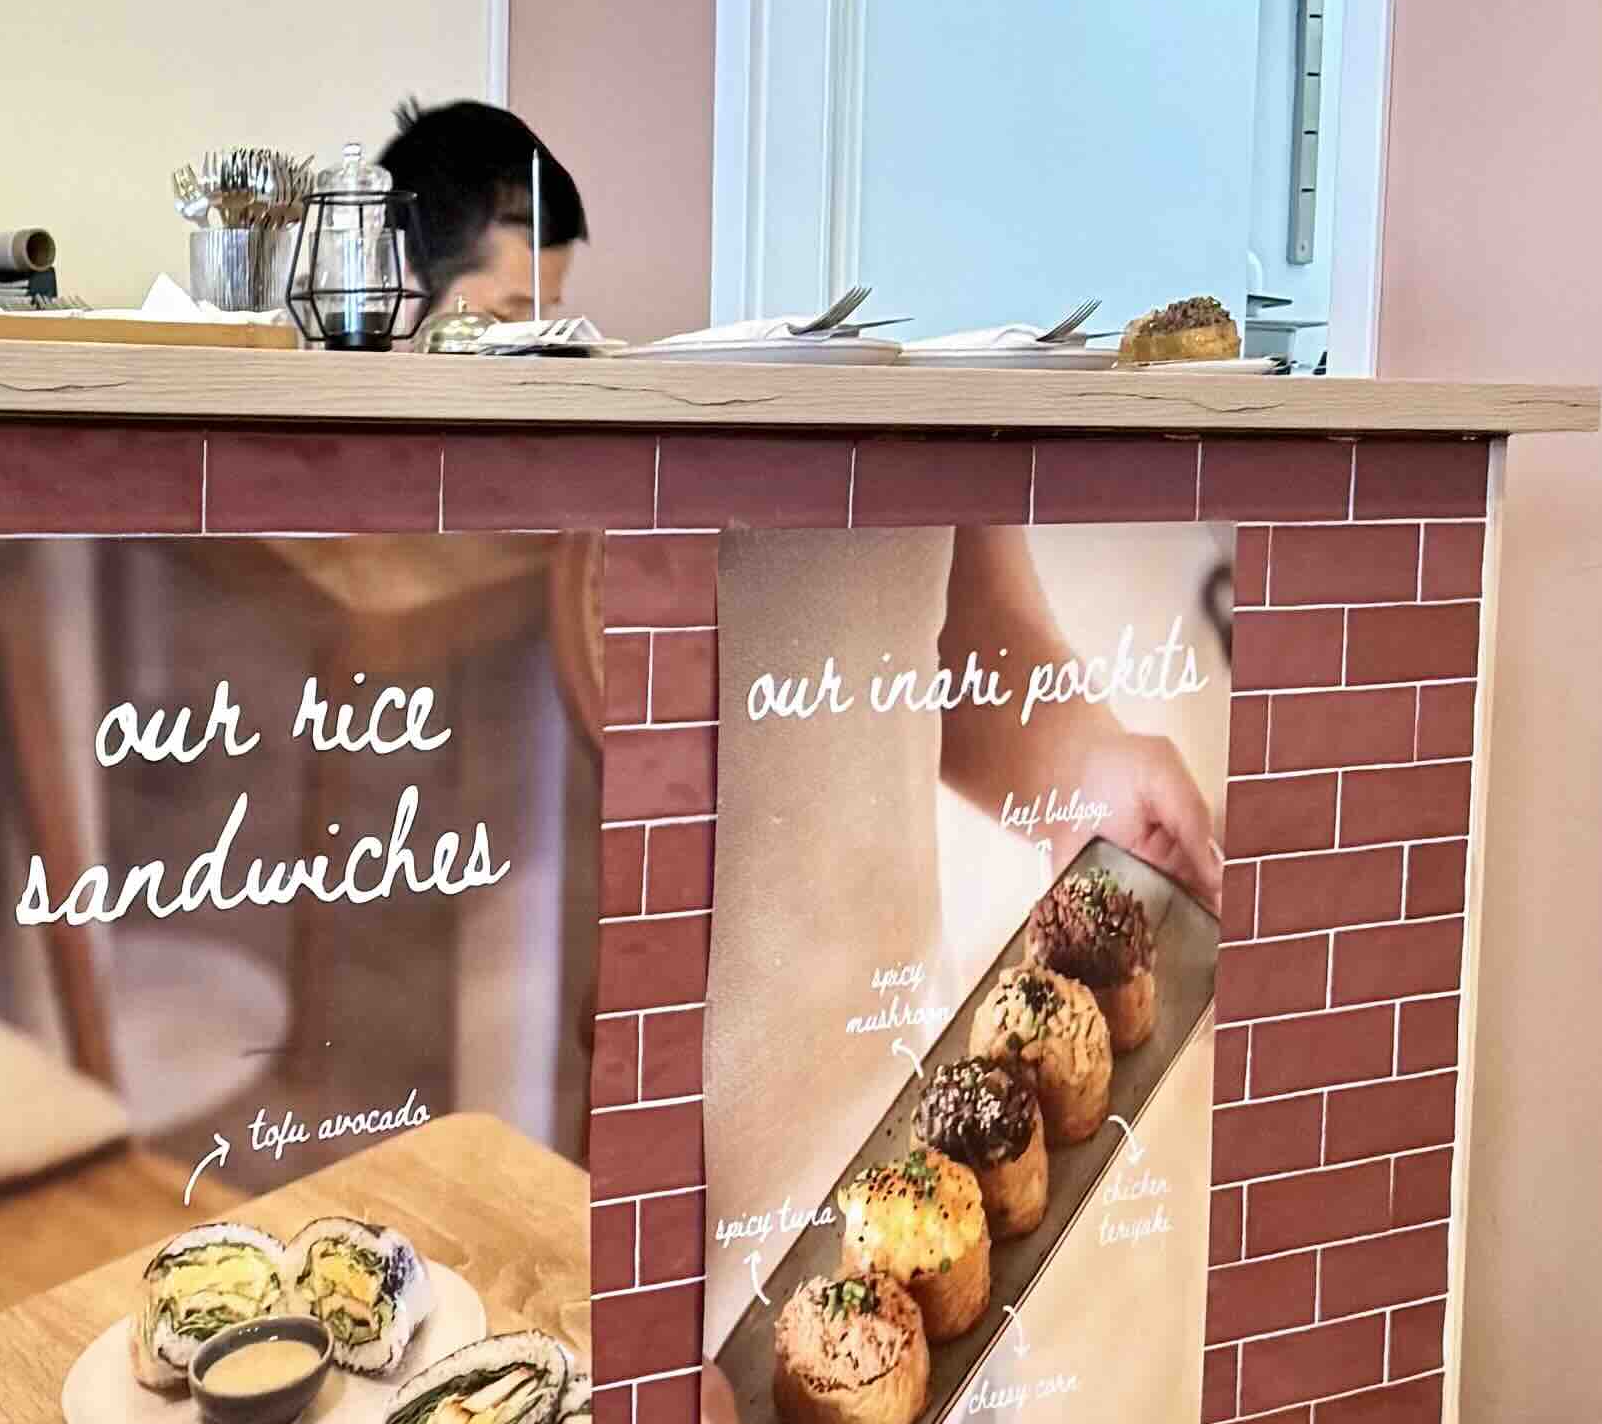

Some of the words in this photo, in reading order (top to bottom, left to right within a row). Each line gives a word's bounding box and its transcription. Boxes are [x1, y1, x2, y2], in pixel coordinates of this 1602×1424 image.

[746, 656, 855, 720] our
[869, 648, 1013, 713] inari
[1021, 616, 1209, 726] pockets
[95, 680, 261, 767] our
[292, 672, 452, 754] rice
[1000, 791, 1042, 835] beef
[15, 785, 511, 926] sandwiches
[871, 961, 924, 997] spicy
[247, 1108, 310, 1161] tofu
[317, 1088, 432, 1140] avocado
[715, 1210, 773, 1248] spicy
[777, 1194, 836, 1233] tuna
